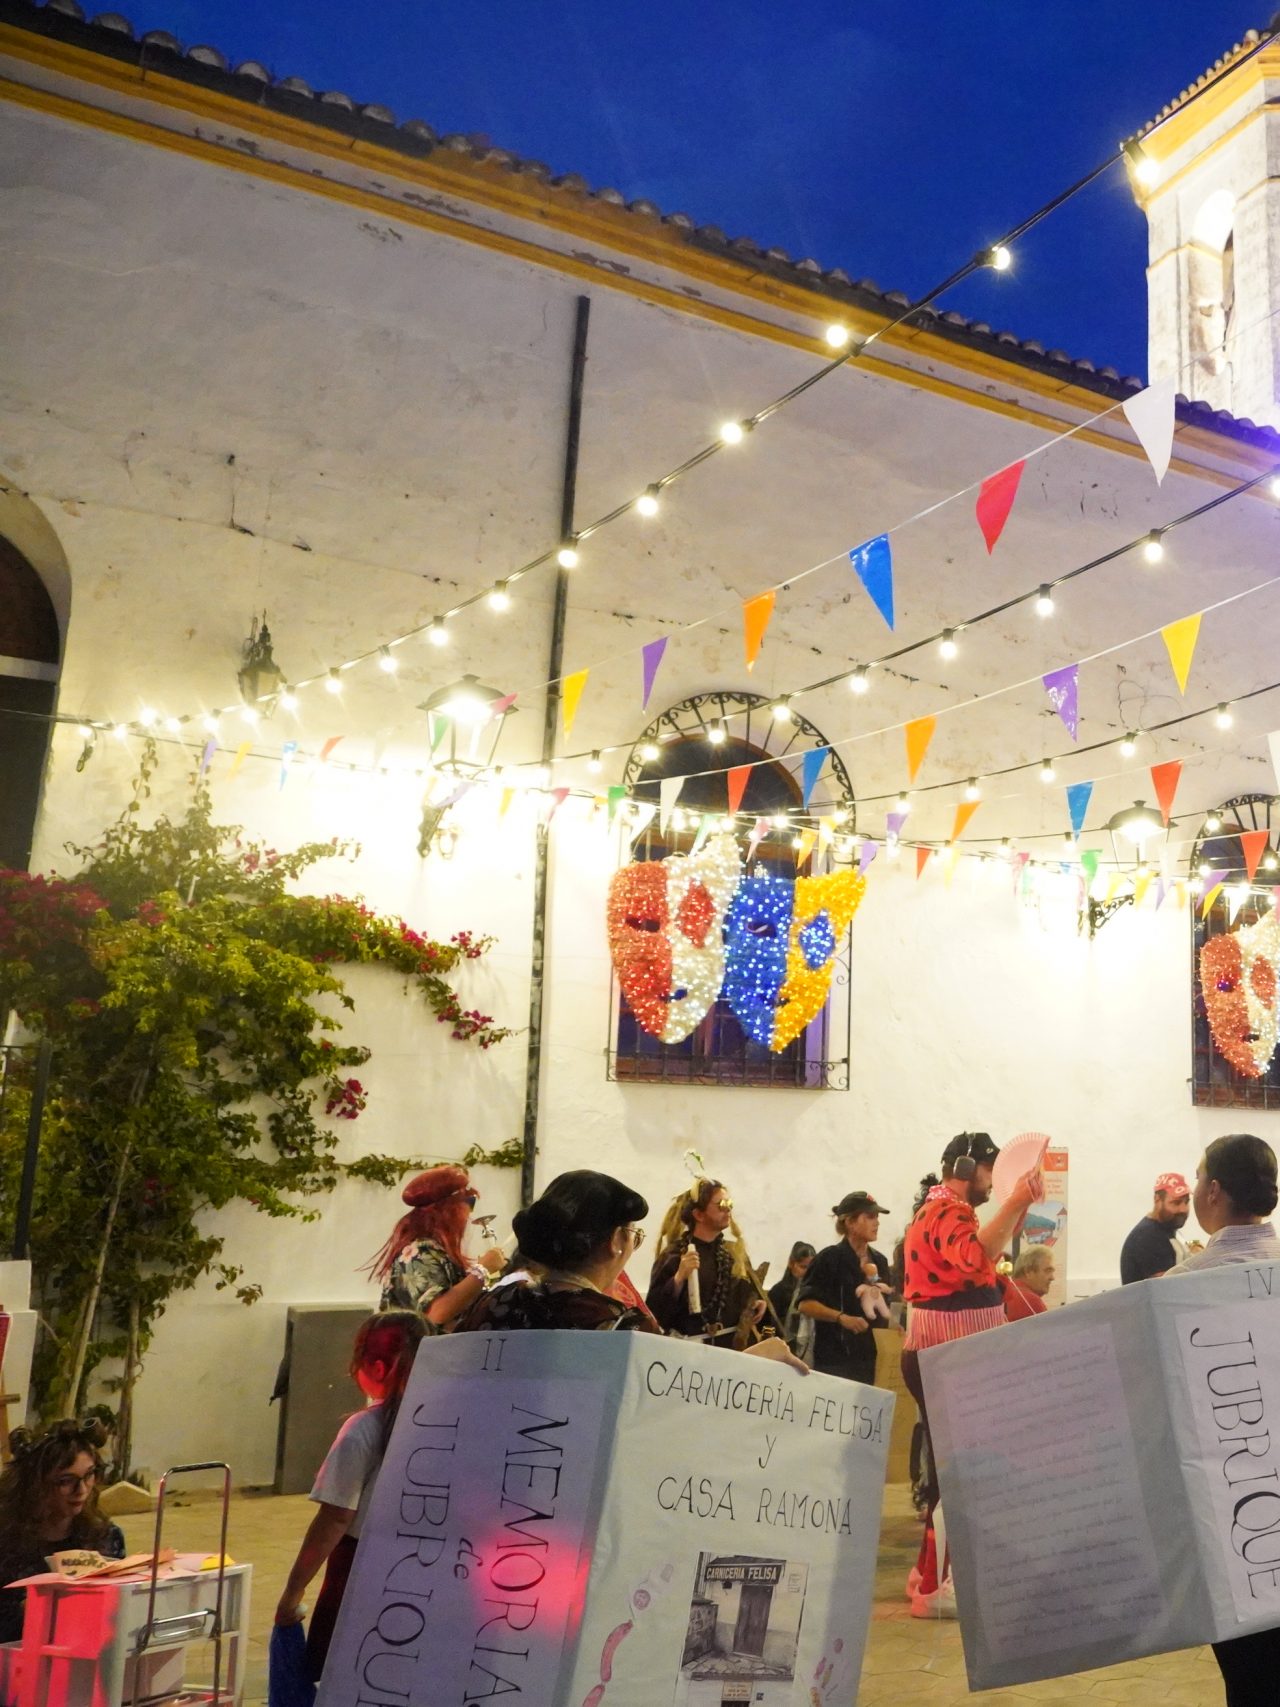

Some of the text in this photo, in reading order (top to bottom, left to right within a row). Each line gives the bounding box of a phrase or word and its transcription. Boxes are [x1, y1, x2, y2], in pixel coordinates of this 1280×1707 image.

[1244, 1267, 1275, 1298] IV
[480, 1338, 507, 1371] II
[646, 1361, 884, 1443] CARNICERÍA FELISA
[657, 1476, 852, 1535] CASA RAMONA
[354, 1403, 461, 1707] JUBRIQU
[453, 1537, 483, 1580] de
[463, 1403, 569, 1707] MEMORIA
[748, 1566, 777, 1580] FELISA
